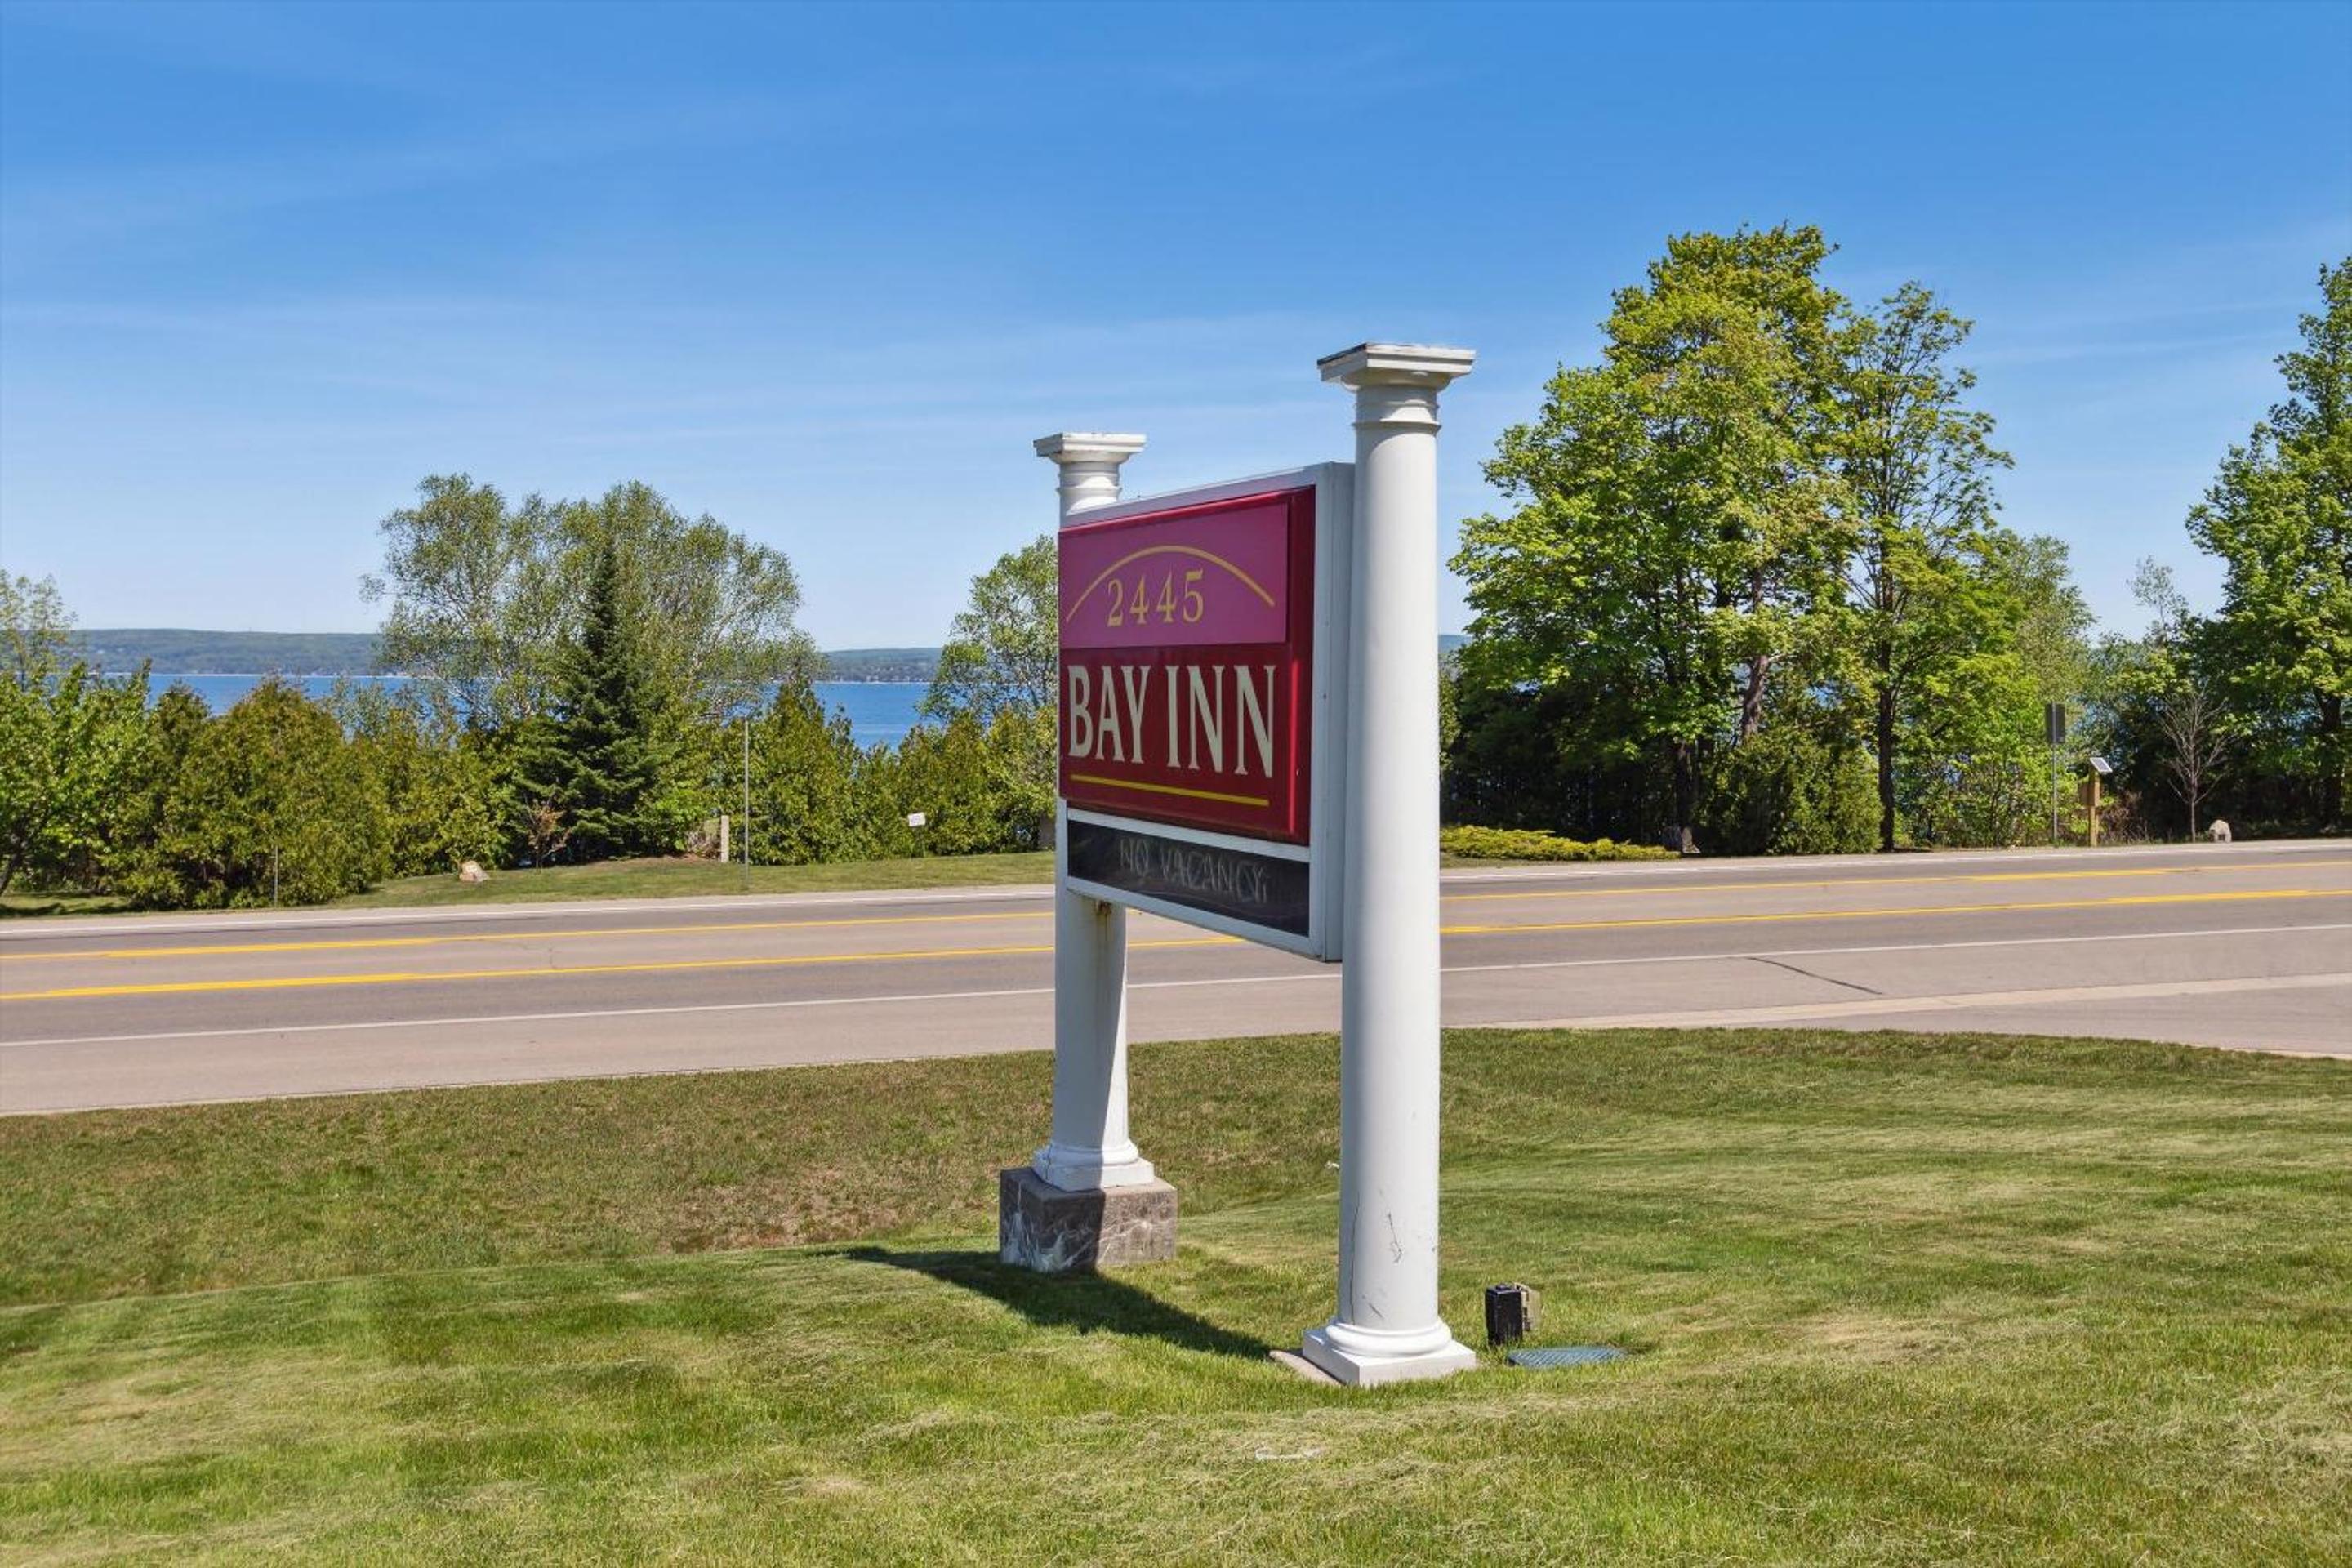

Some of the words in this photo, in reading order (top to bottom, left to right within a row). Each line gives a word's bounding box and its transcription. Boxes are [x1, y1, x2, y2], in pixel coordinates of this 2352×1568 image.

[1107, 569, 1204, 627] 2445
[1067, 665, 1151, 764] BAY
[1165, 664, 1277, 777] INN
[1120, 837, 1150, 878] NO
[1160, 846, 1267, 904] VACANCY
